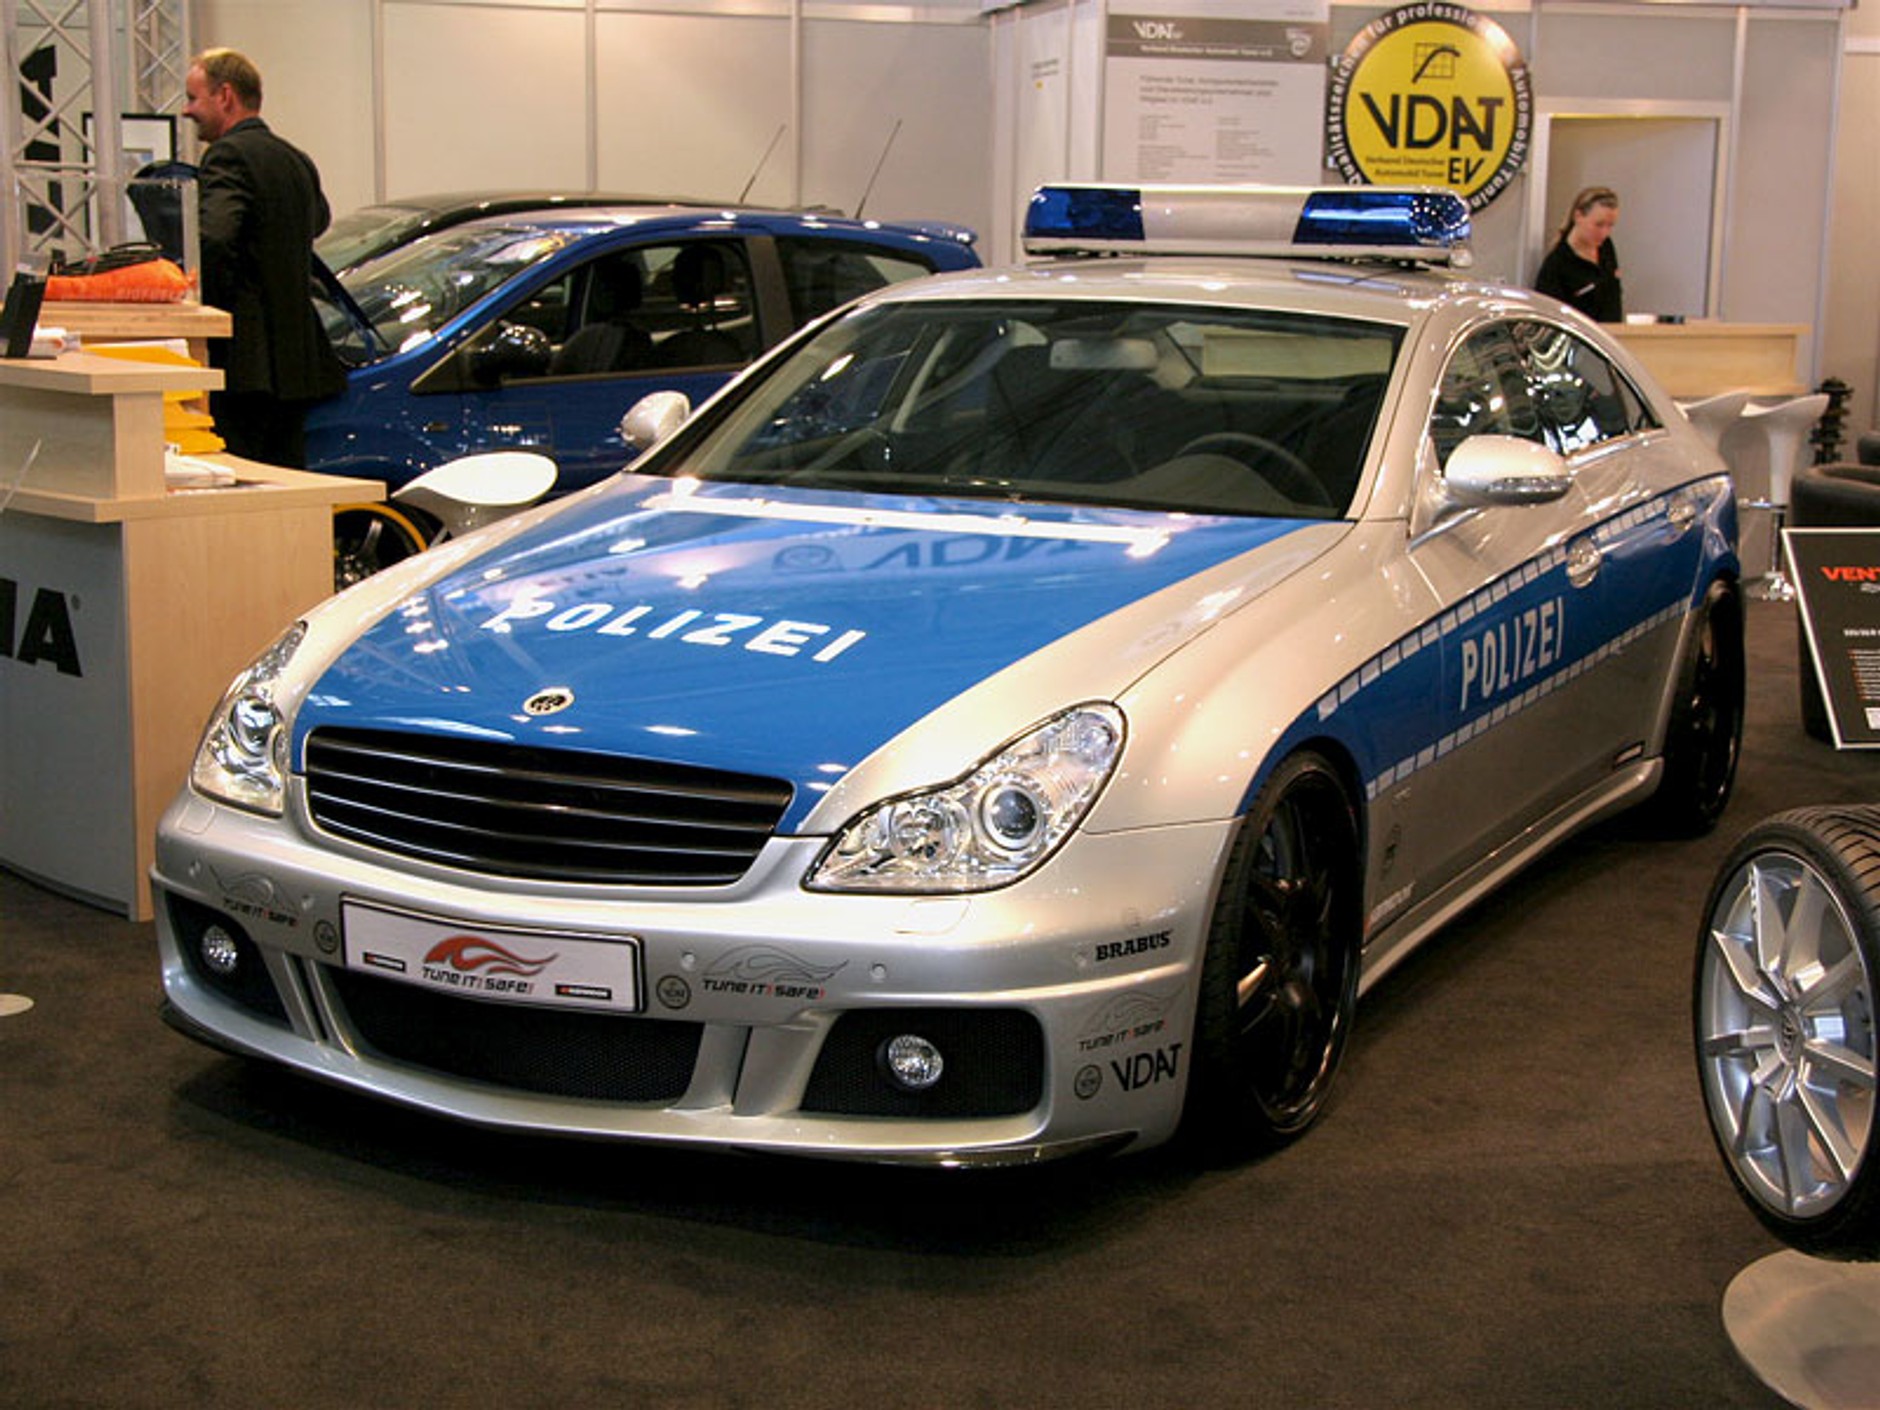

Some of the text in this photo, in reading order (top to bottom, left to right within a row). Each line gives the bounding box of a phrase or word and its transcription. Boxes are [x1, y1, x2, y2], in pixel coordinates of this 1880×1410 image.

[1358, 92, 1504, 151] VDAT
[1507, 67, 1530, 167] Automobil
[1447, 157, 1485, 184] EV
[1470, 169, 1513, 208] Tunin
[480, 600, 866, 662] POLIZEI
[1460, 596, 1564, 711] POLIZEI
[1095, 929, 1173, 962] BRABUS
[1111, 1042, 1183, 1092] VDAT
